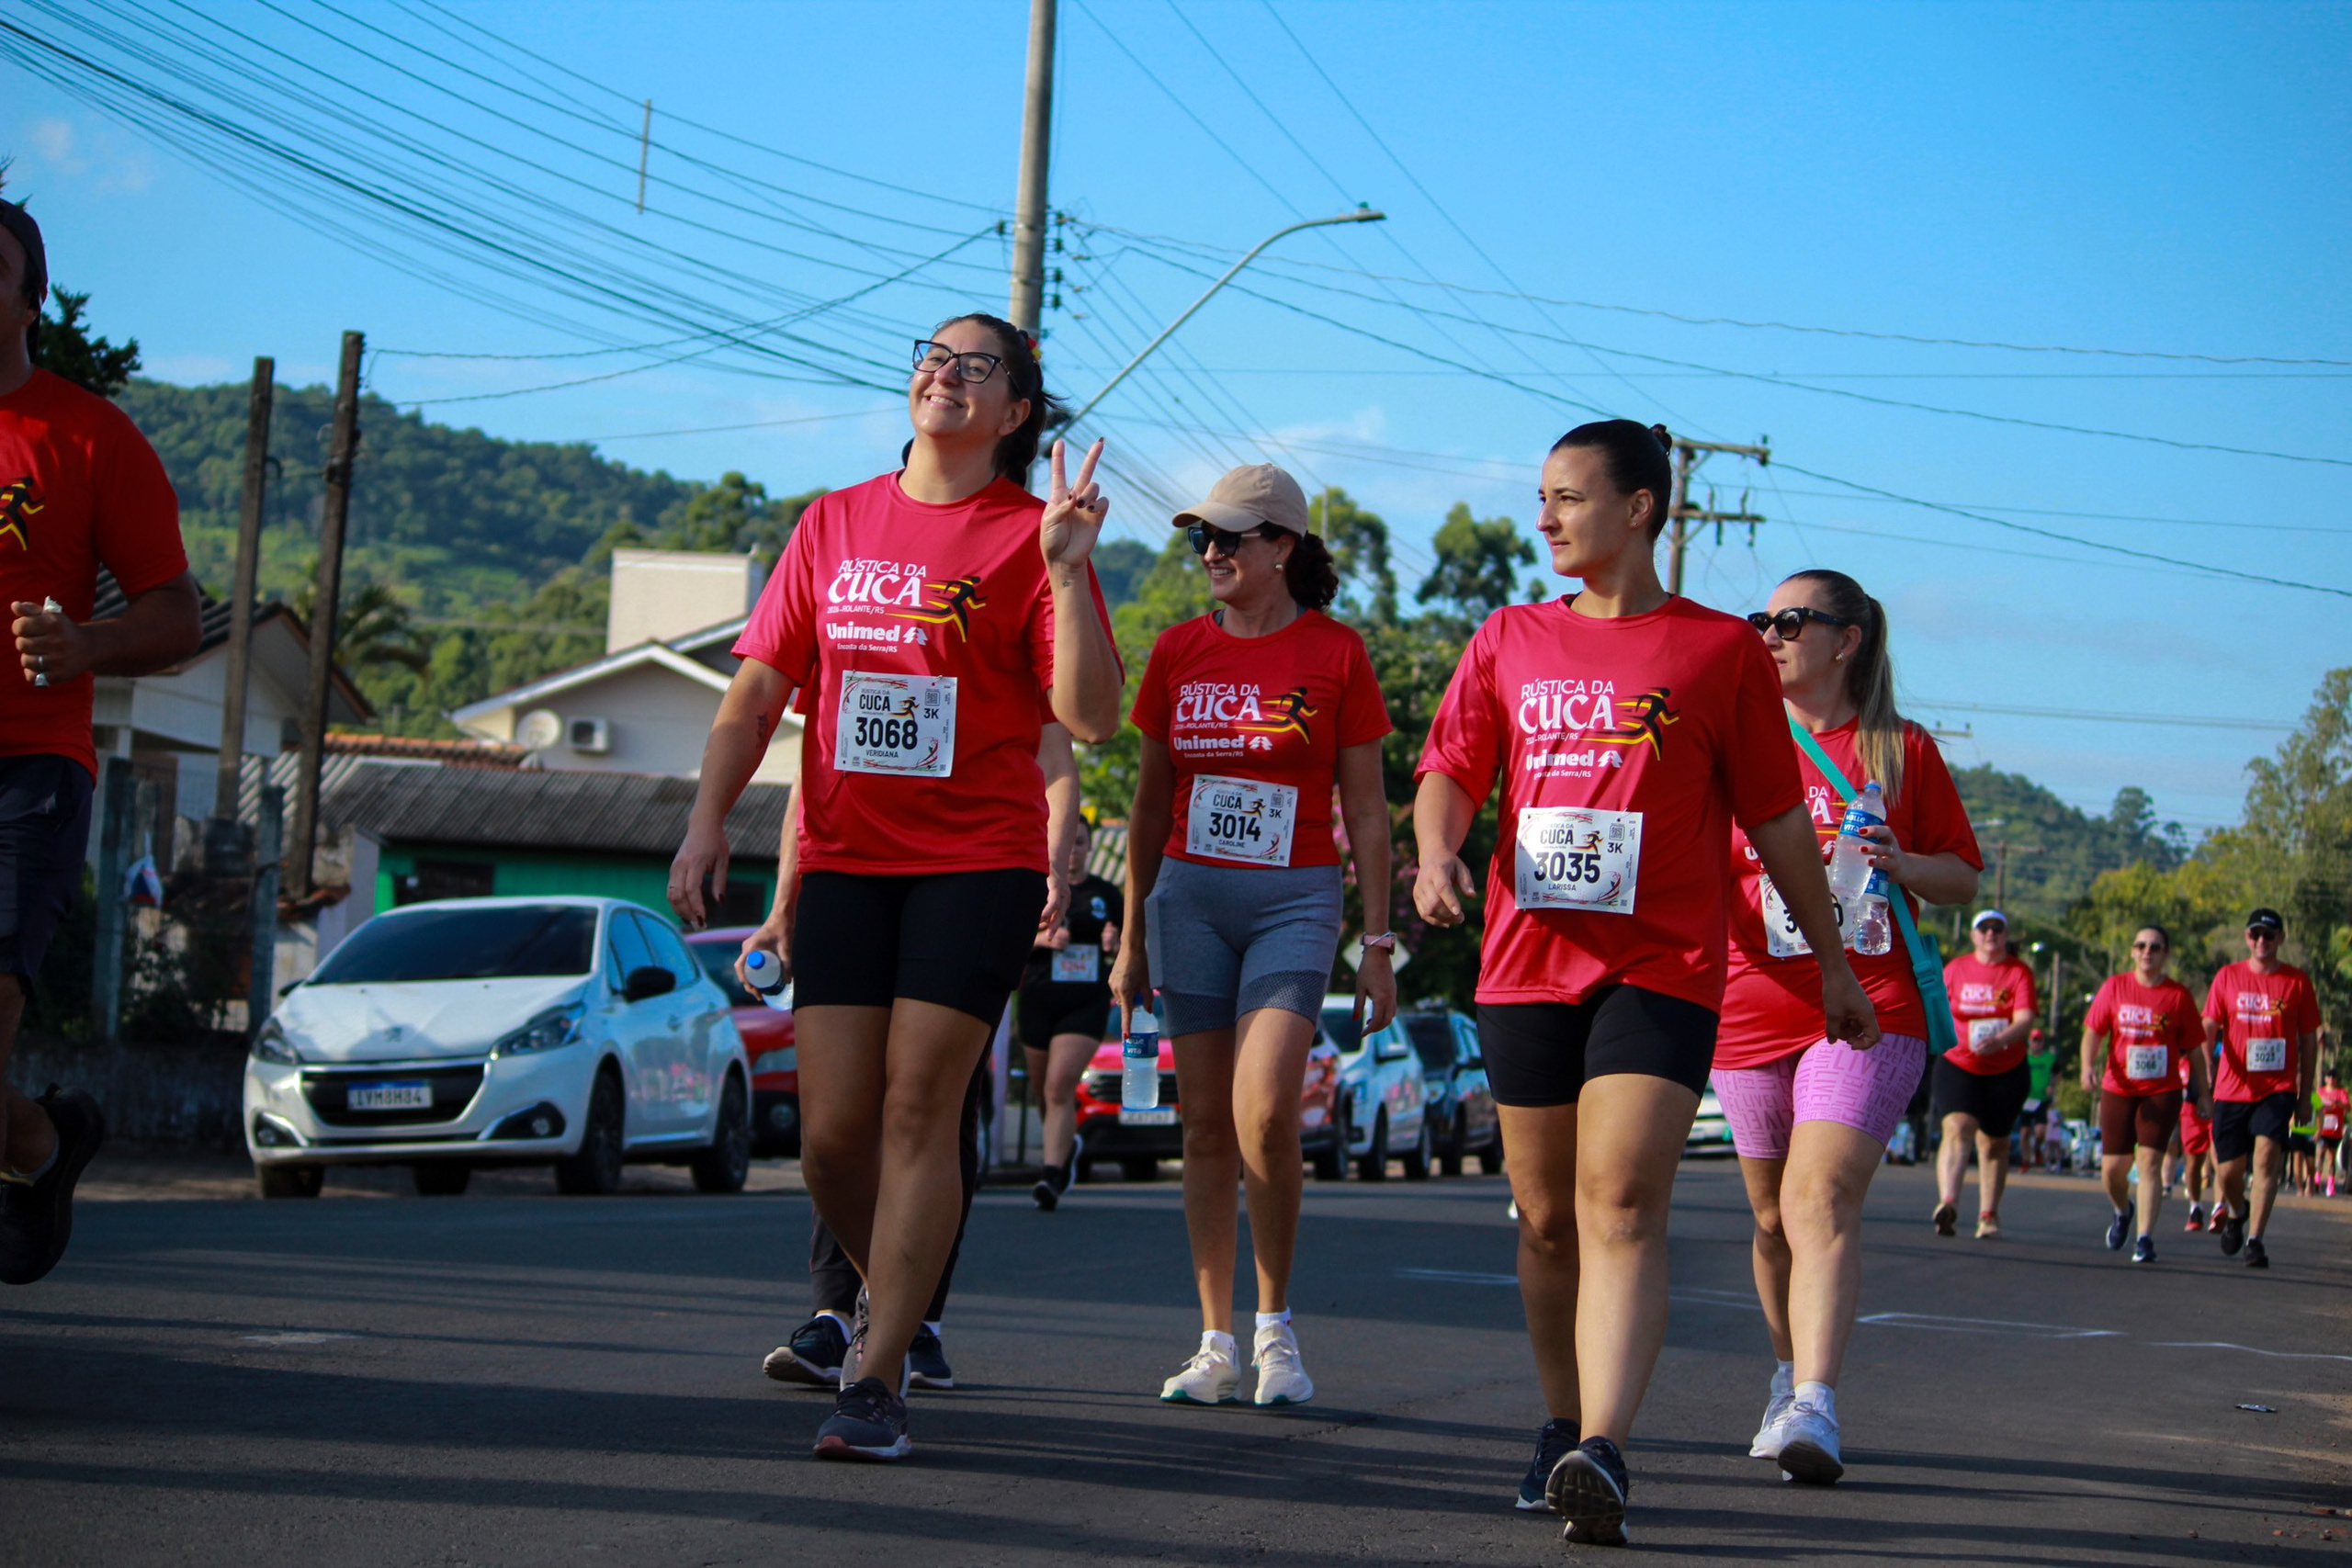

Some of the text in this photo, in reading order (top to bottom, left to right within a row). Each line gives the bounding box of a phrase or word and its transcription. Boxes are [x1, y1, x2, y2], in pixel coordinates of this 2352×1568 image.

[838, 557, 927, 578] RÚSTICA DA
[827, 572, 922, 608] CUCA
[826, 621, 901, 642] Unimed
[868, 644, 898, 653] Serra/RS
[1180, 681, 1261, 697] RÚSTICA DA
[1521, 678, 1615, 700] RÚSTICA DA
[859, 694, 891, 711] CUCA
[1176, 694, 1262, 722] CUCA
[923, 708, 940, 719] 3K
[1518, 694, 1616, 735] CUCA
[854, 716, 919, 750] 3068
[1173, 735, 1245, 750] Unimed
[865, 750, 899, 759] VERIDIANA
[1560, 770, 1592, 778] Serra/RS
[1809, 785, 1828, 798] DA
[1213, 794, 1242, 809] CUCA
[1269, 808, 1283, 818] 3K
[1209, 812, 1261, 842] 3014
[1218, 839, 1246, 848] CAROLINE
[1540, 829, 1574, 845] CUCA
[1607, 842, 1623, 854] 3K
[1533, 852, 1601, 884] 3035
[1548, 883, 1577, 892] LARISSA
[2236, 994, 2269, 1010] CUCA
[2118, 1008, 2152, 1024] CUCA
[1834, 1050, 1897, 1086] LIVE!
